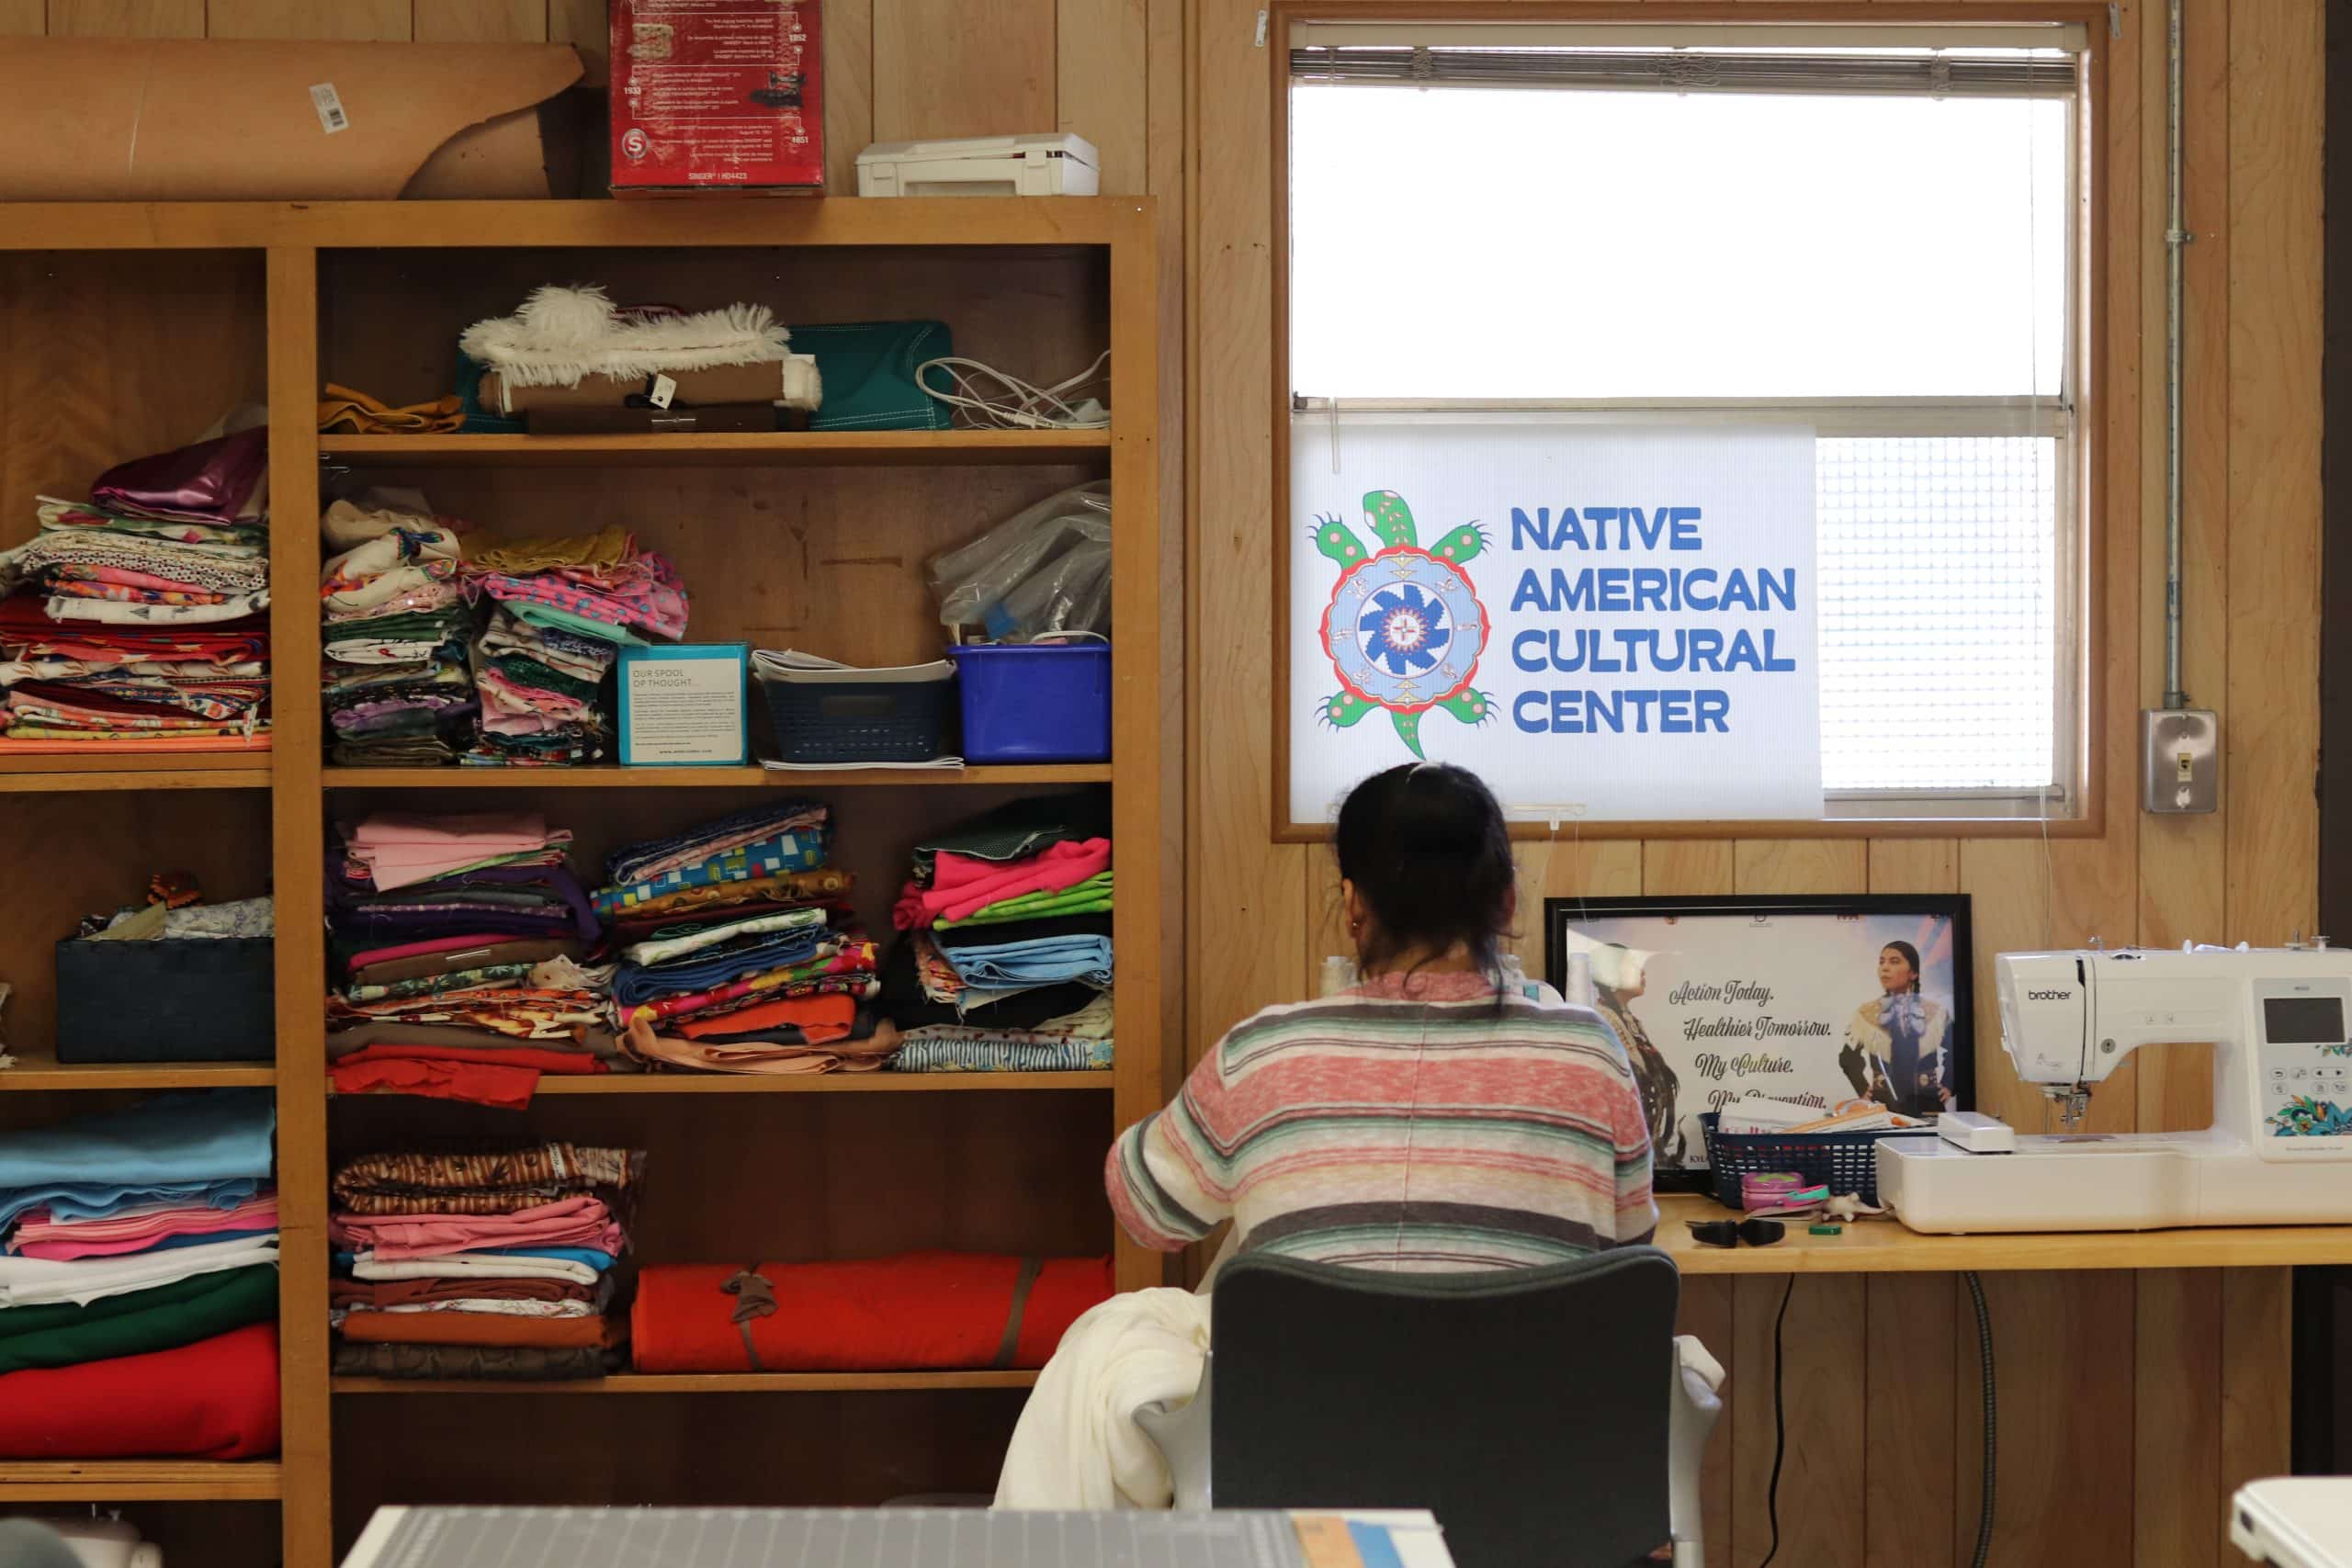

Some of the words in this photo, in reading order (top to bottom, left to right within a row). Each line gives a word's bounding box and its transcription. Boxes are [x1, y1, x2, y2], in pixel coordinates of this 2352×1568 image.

[1511, 507, 1702, 551] NATIVE
[1510, 568, 1796, 612] AMERICAN
[1511, 628, 1796, 672] CULTURAL
[632, 670, 653, 678] OUR
[654, 669, 684, 678] SPOOL
[648, 678, 692, 688] THOUGHT
[1512, 690, 1730, 734] CENTER
[1668, 979, 1722, 1006] Action
[1724, 979, 1775, 1008] Today.
[2028, 988, 2073, 1000] brother
[1683, 1016, 1753, 1042] Healthier
[1754, 1016, 1831, 1042] Tomorrow.
[1695, 1053, 1727, 1081] My
[1730, 1053, 1794, 1077] Culture.
[1708, 1089, 1741, 1113] M
